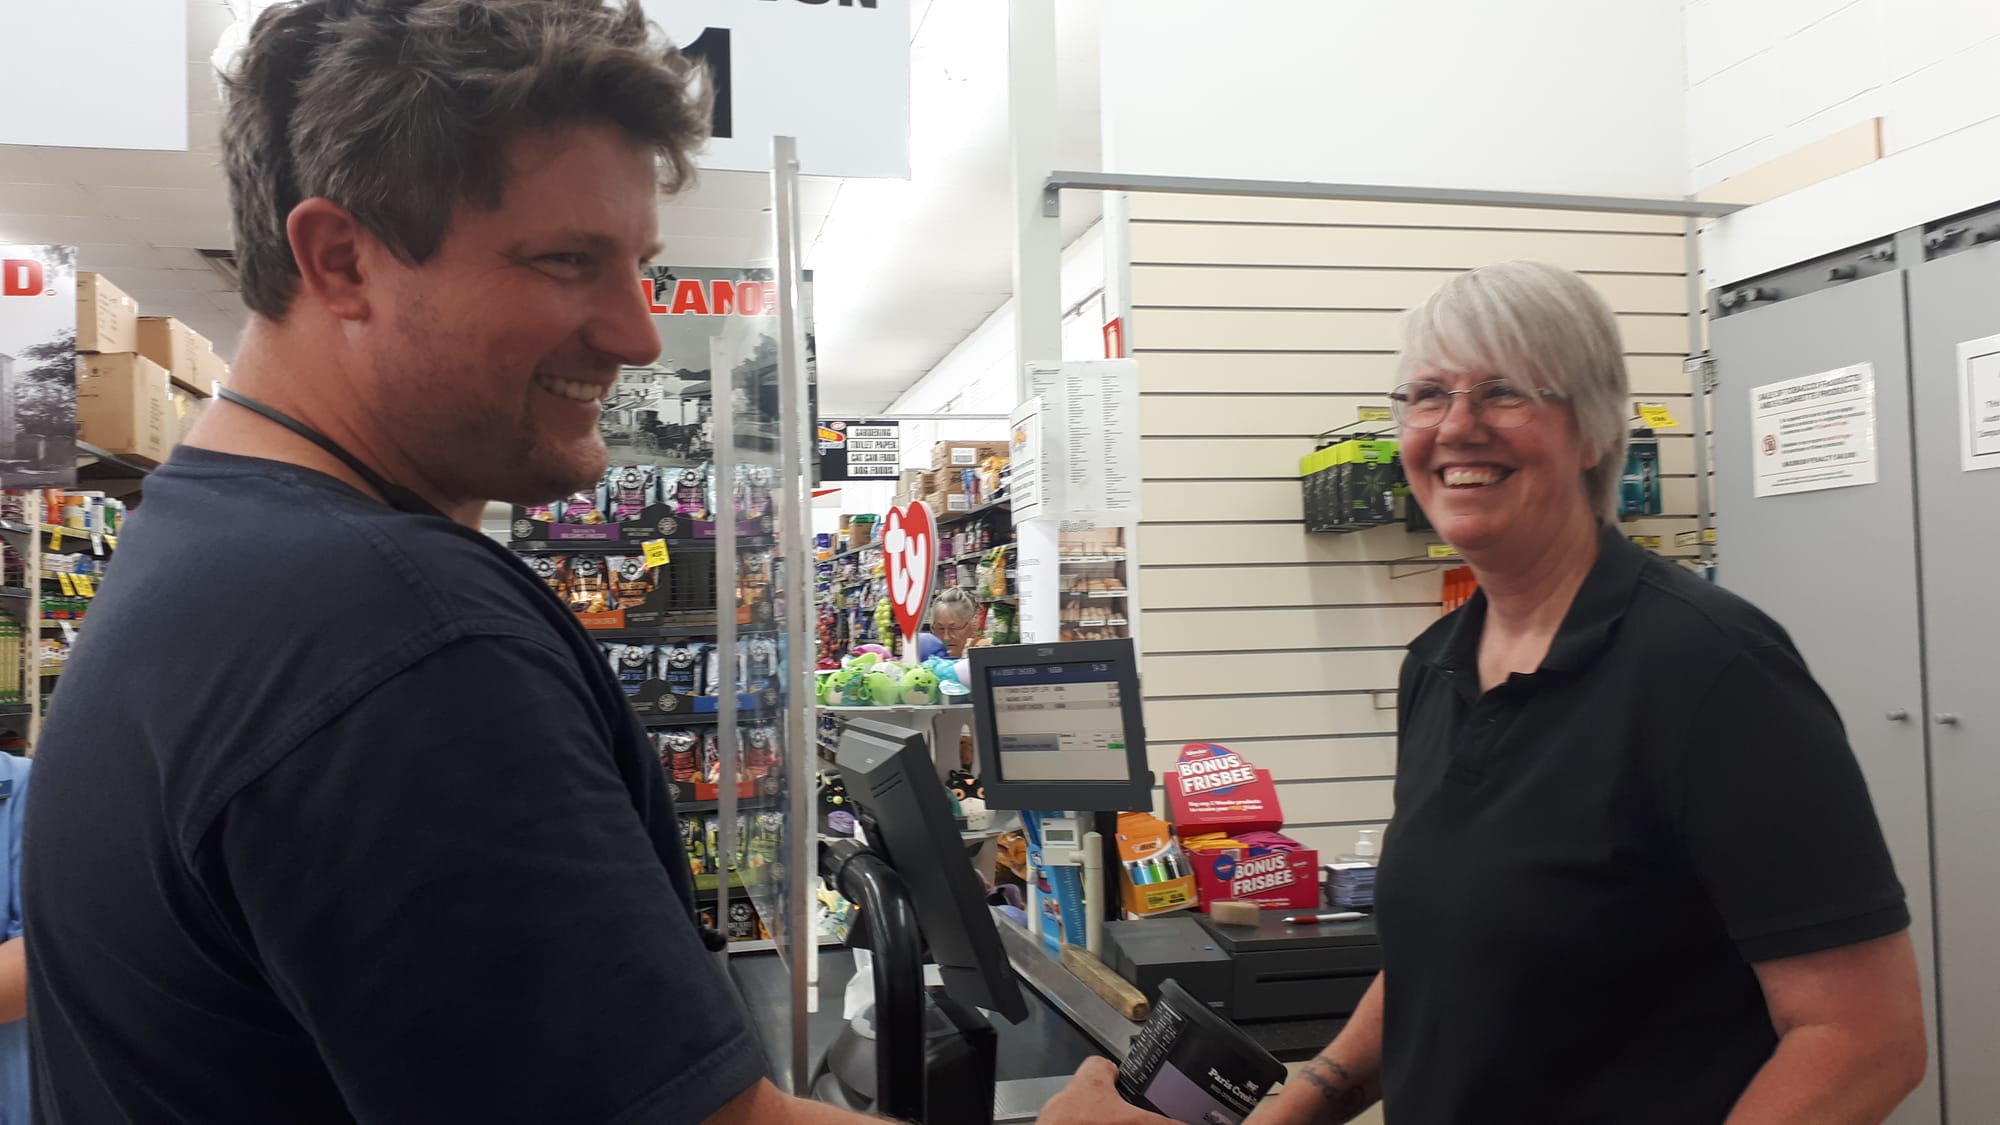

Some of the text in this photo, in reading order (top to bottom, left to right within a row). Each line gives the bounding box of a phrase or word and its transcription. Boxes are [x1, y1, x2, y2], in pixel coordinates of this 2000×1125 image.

[850, 441, 873, 449] TOILET
[885, 512, 927, 616] ty
[1178, 755, 1240, 777] BONUS
[1181, 766, 1254, 794] FRISBEE
[1234, 855, 1286, 879] BONUS
[1233, 870, 1293, 896] FRISBEE
[1208, 1067, 1233, 1090] Paris
